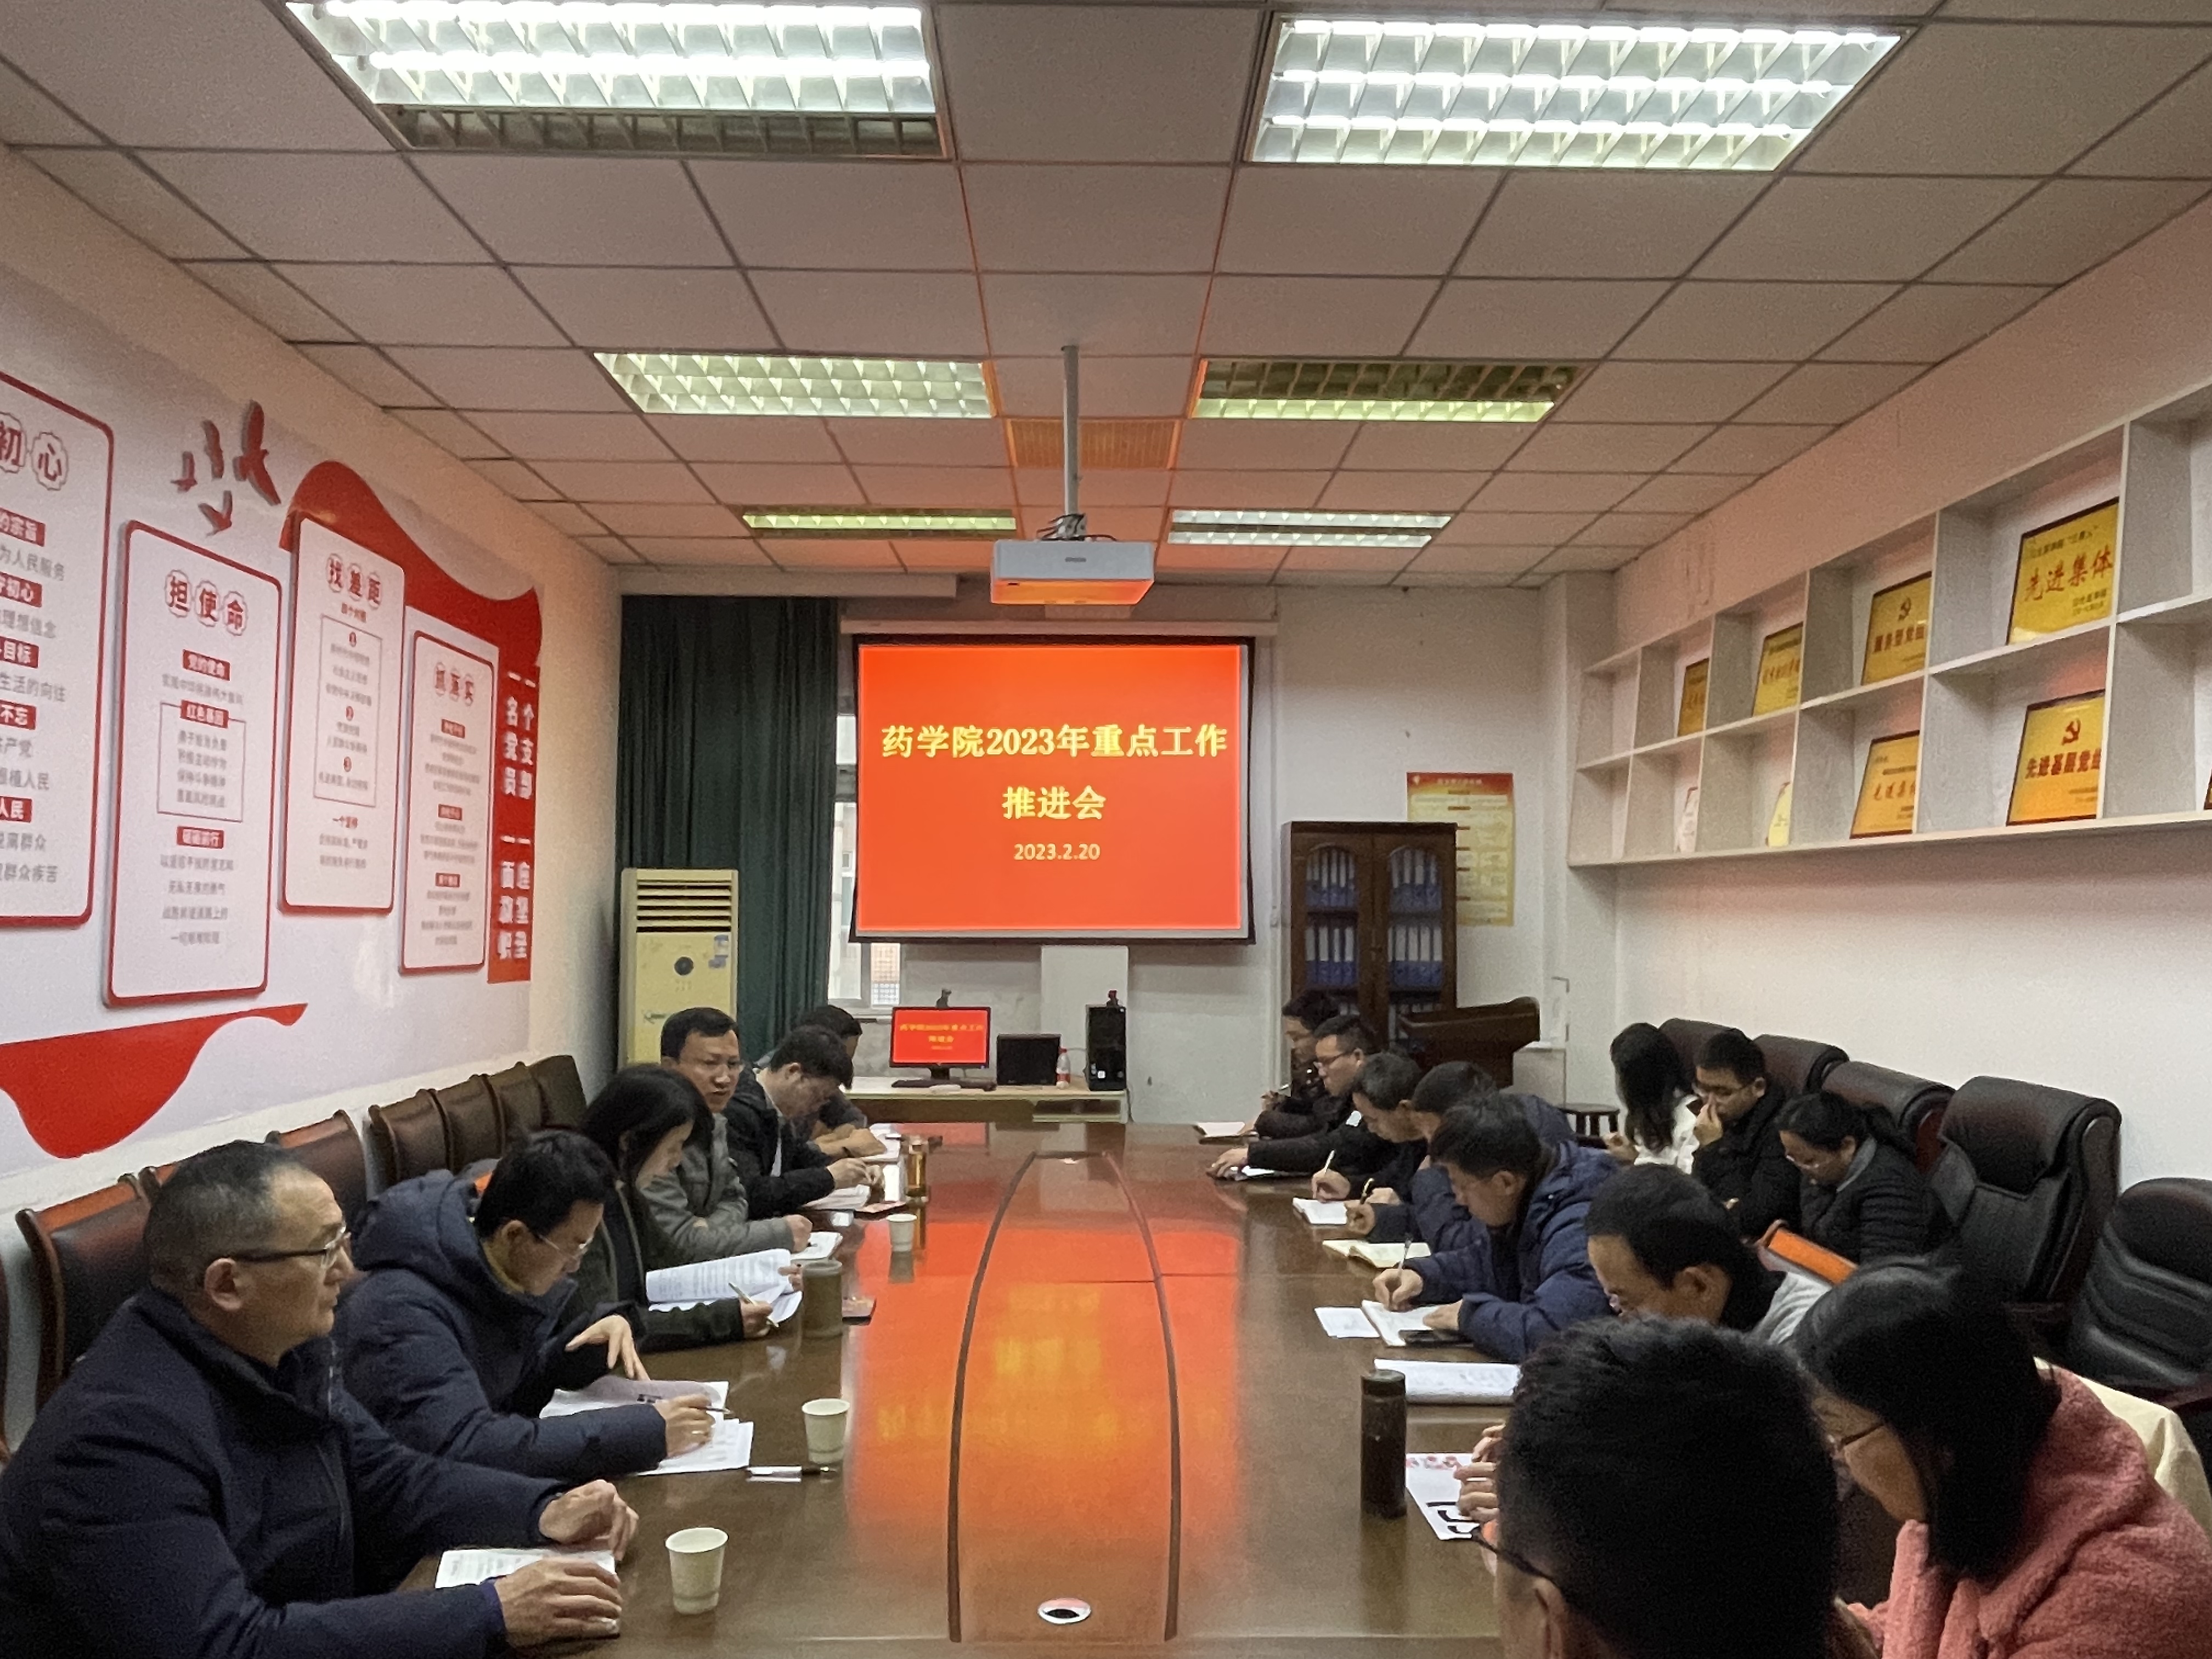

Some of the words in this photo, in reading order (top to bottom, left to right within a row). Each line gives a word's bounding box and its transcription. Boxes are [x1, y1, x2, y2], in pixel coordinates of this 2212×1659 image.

[0, 420, 62, 482] 初心
[330, 558, 381, 606] 找差距
[2024, 544, 2114, 602] 先进集体
[169, 575, 244, 631] 担使命
[504, 672, 521, 796] 一名党员
[519, 678, 536, 800] 一个支部
[881, 724, 1227, 758] 药学院2023年重点工作
[1002, 785, 1106, 820] 推进会
[1014, 843, 1101, 861] 2023.2.20
